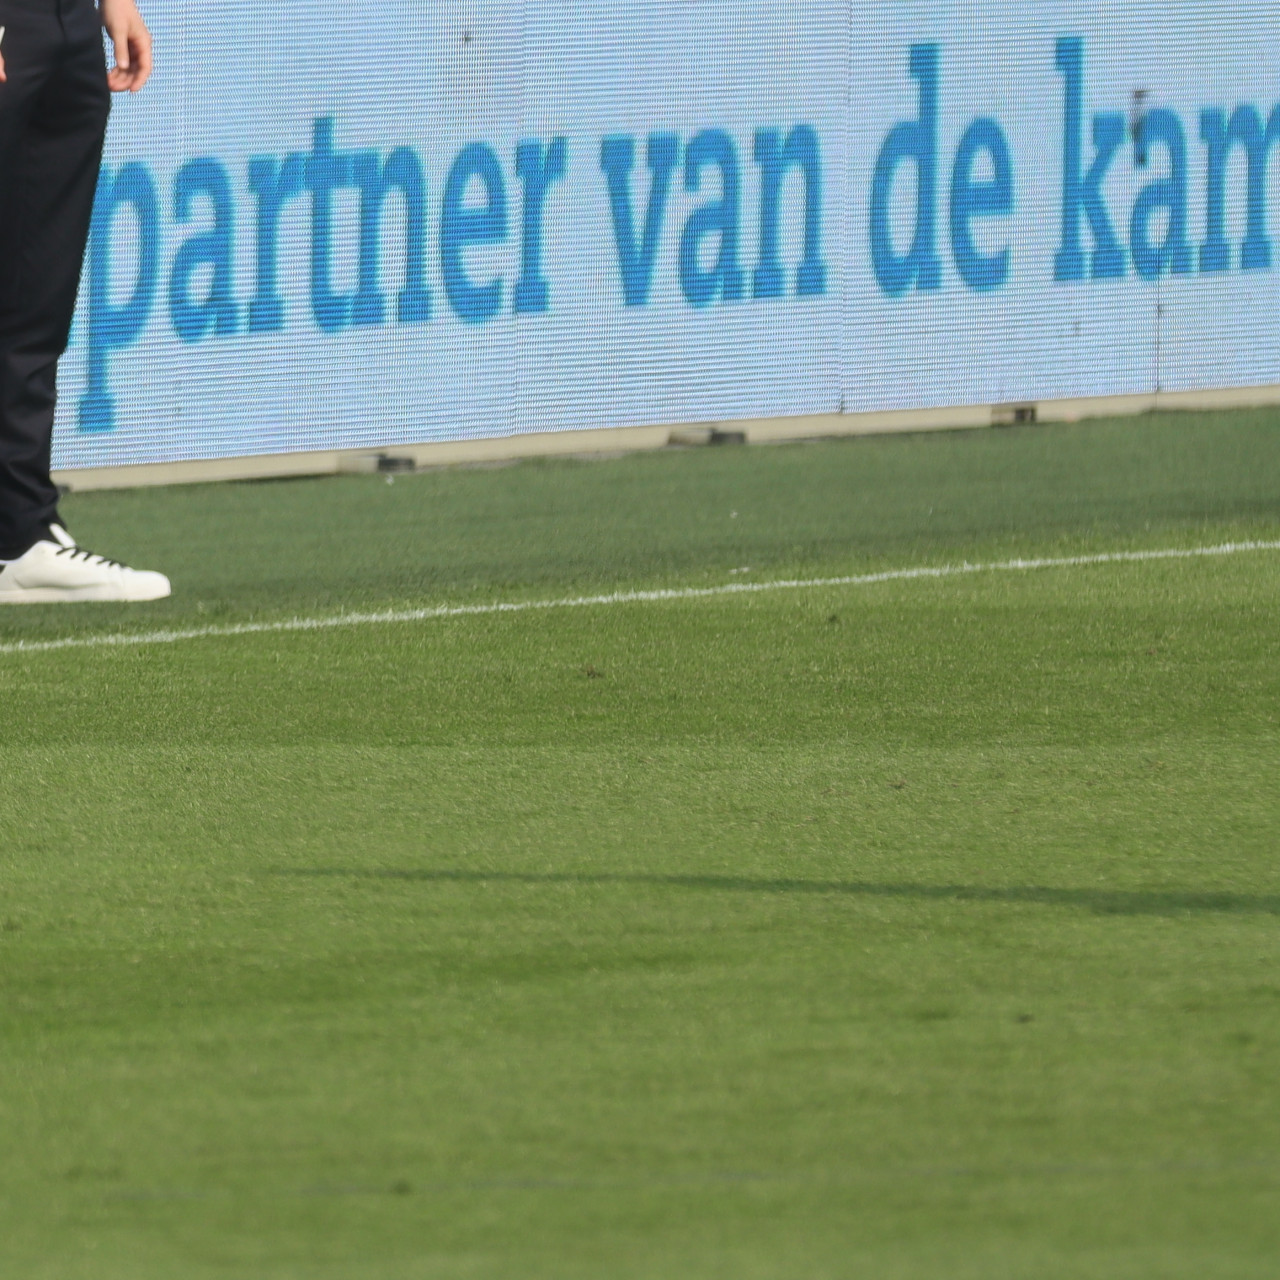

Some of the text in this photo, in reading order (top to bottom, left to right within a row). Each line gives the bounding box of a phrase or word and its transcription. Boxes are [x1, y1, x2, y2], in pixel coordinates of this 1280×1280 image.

[74, 113, 567, 433] partner
[598, 122, 828, 310] van
[867, 43, 1015, 298] de
